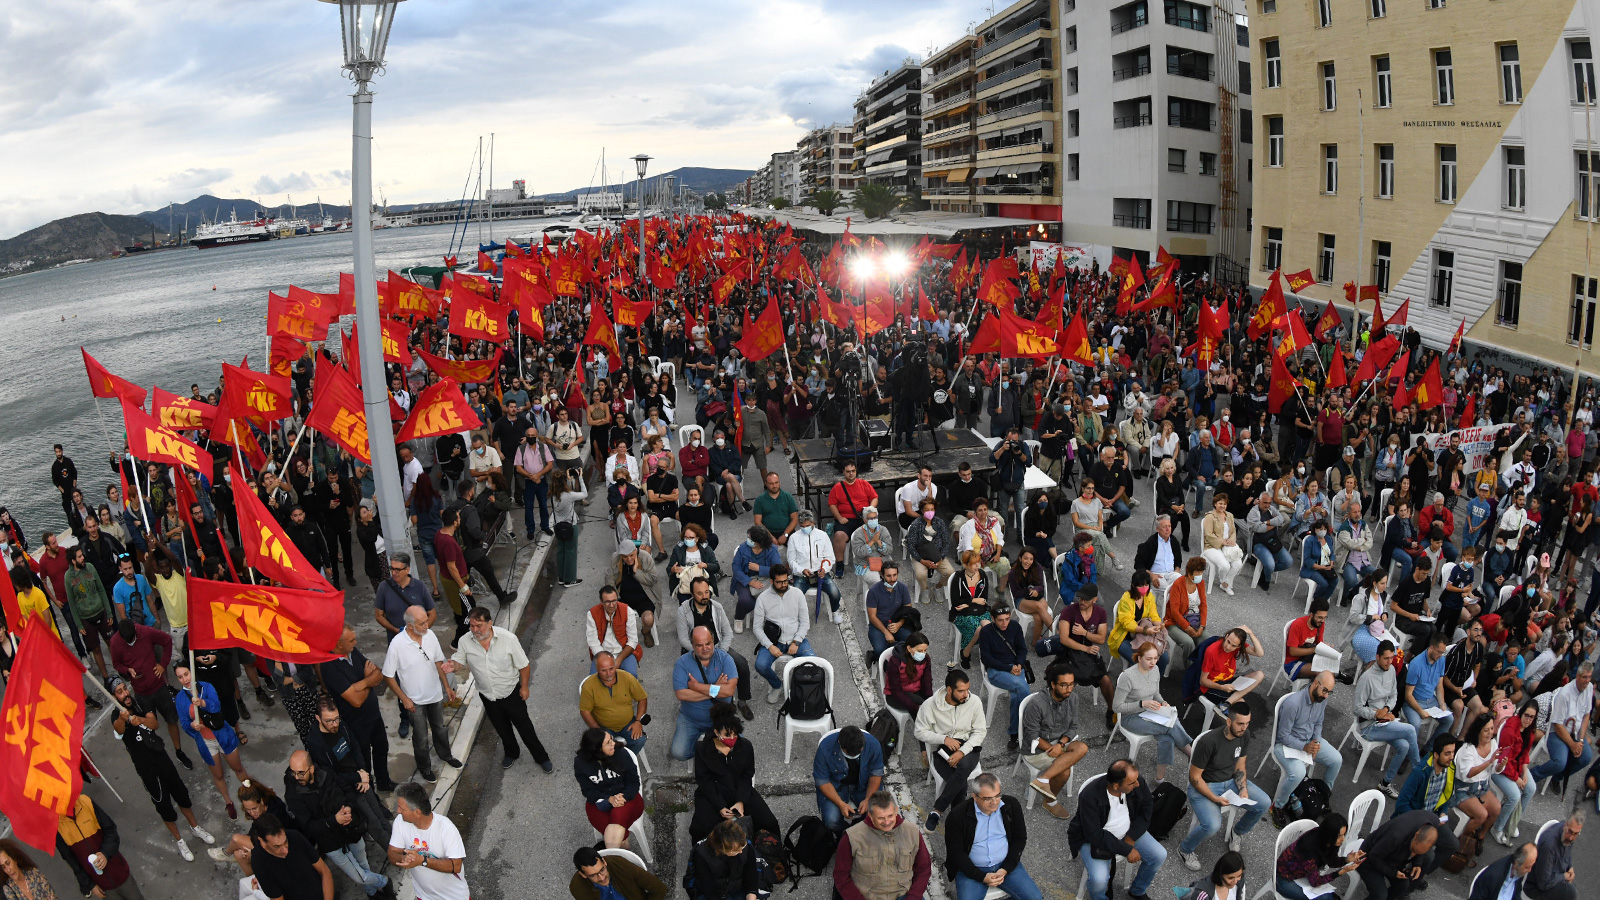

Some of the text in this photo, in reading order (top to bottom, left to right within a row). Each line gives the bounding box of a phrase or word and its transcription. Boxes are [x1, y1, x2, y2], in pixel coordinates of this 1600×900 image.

[1403, 120, 1502, 128] ΠΑΝΕΠΙΣΤΗΜΙΟ ΘΕΣΣΑΛΙΑΣ
[277, 314, 315, 339] ΚΚΕ
[465, 309, 498, 336] ΚΚΕ
[1016, 333, 1057, 354] ΚΚΕ
[246, 391, 278, 412] ΚΚΕ
[160, 406, 203, 428] ΚΚΕ
[413, 401, 463, 437] ΚΚΕ
[145, 427, 200, 469] ΚΚΕ
[210, 602, 311, 654] ΚΚΕ
[23, 677, 78, 815] ΚΚΕ
